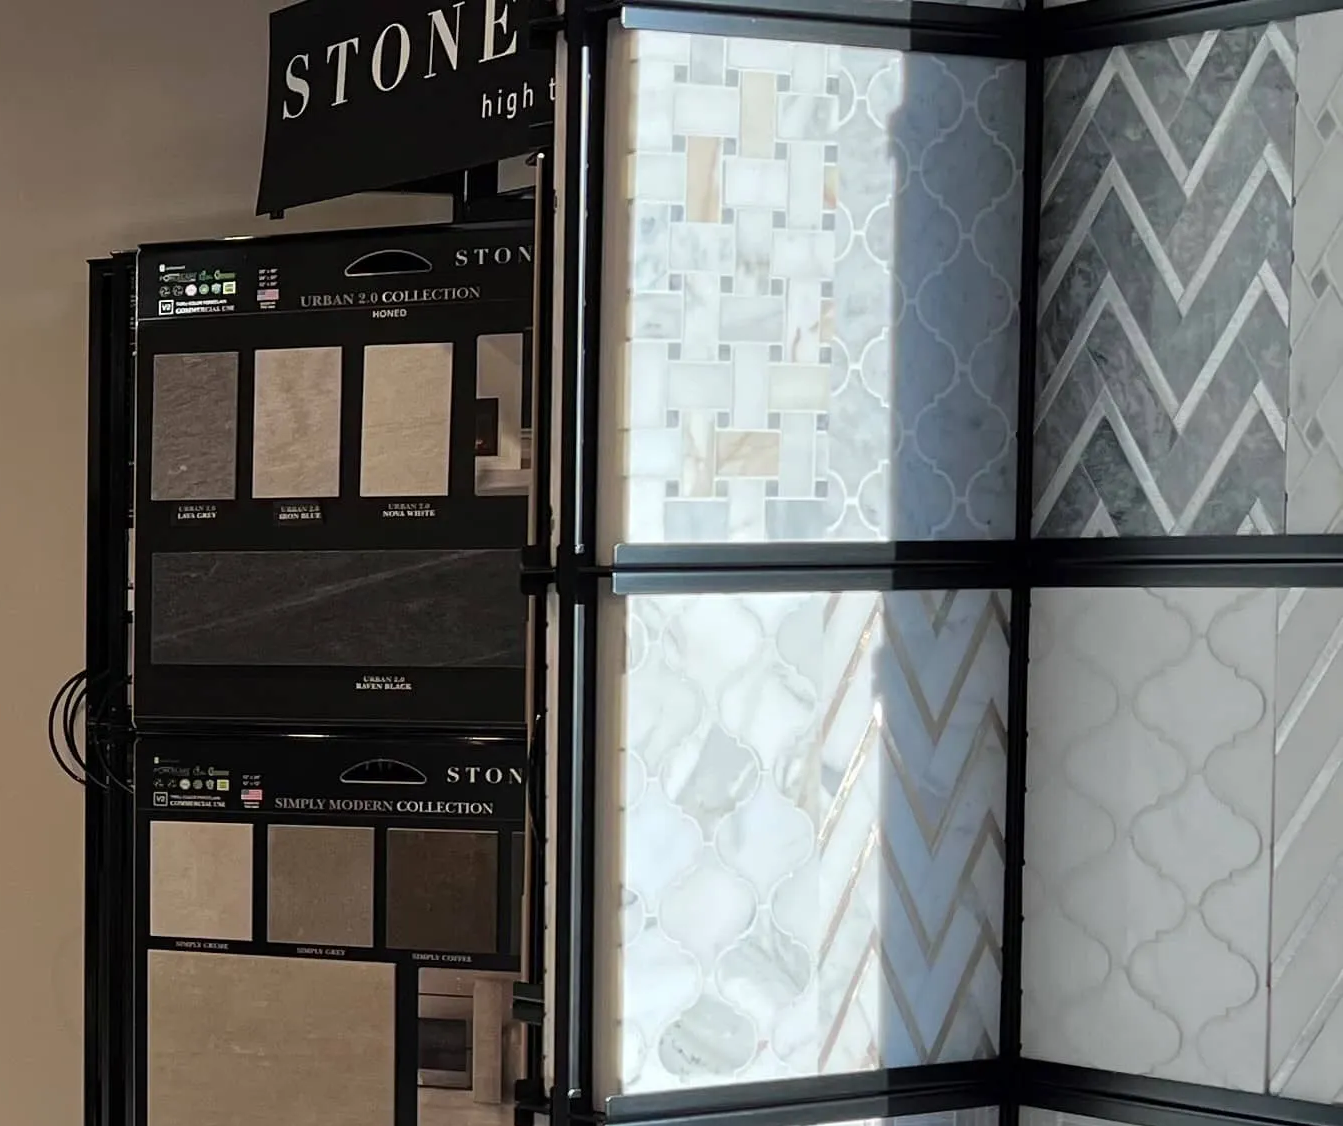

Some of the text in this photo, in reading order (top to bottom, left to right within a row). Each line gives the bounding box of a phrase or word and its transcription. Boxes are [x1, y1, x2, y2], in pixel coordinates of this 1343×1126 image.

[482, 82, 534, 119] high
[300, 286, 481, 308] URBAN 2.0 COLLECTION
[372, 308, 407, 319] HONED
[407, 509, 436, 517] WHITE
[274, 797, 326, 811] SIMPLY
[328, 799, 394, 812] MODERN
[396, 800, 494, 815] COLLECTION
